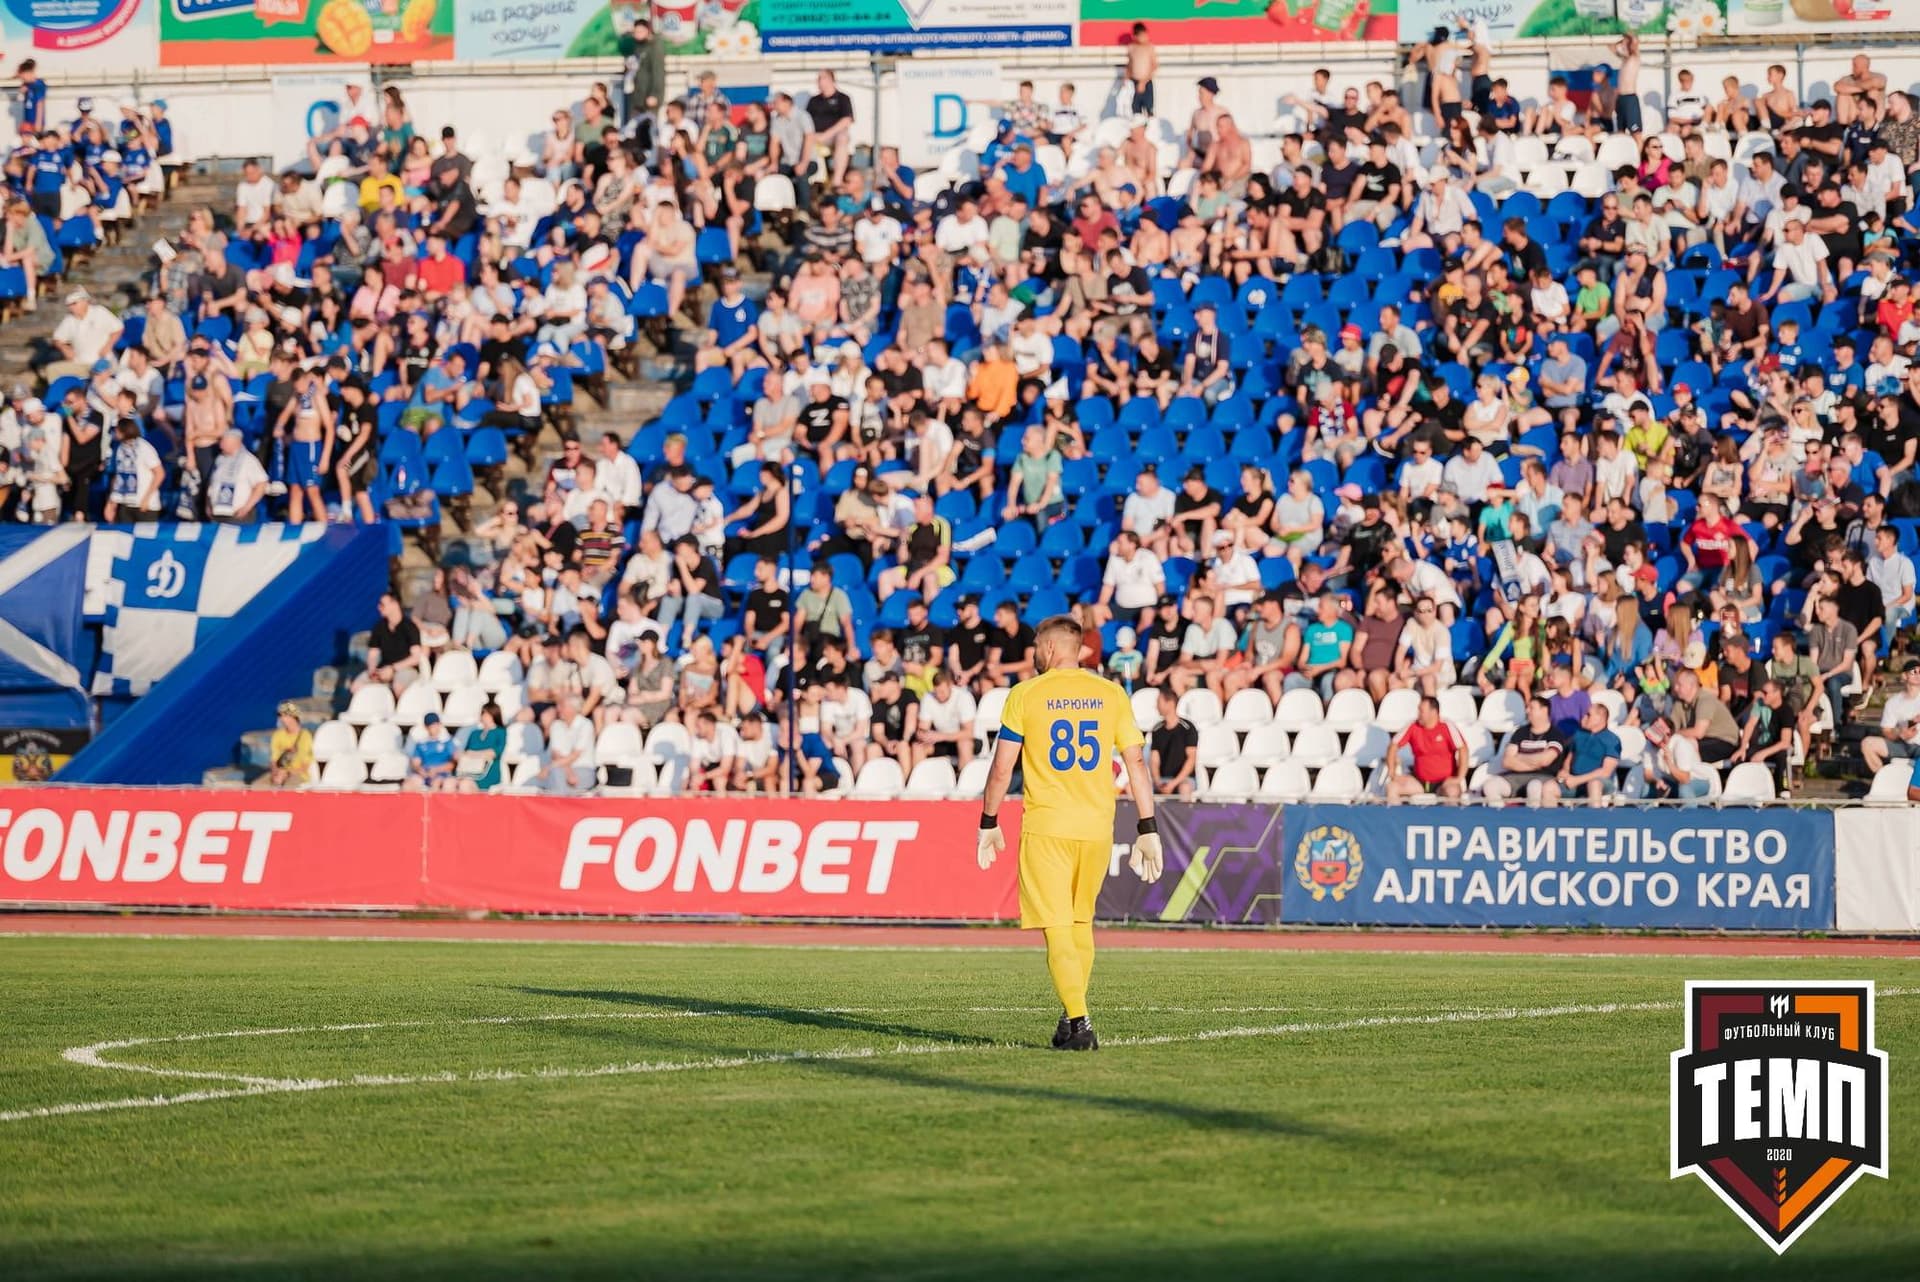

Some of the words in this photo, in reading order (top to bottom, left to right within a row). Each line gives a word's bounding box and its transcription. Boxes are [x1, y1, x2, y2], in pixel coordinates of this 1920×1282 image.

[1047, 699, 1104, 711] КАРЮКИН
[1049, 718, 1101, 772] 85
[0, 808, 293, 884] ONBET
[559, 816, 919, 894] FONBET
[1405, 825, 1787, 865] ПРАВИТЕЛЬСТВО
[1373, 861, 1680, 908] АЛТАЙСКОГО
[1697, 872, 1811, 909] КРАЯ
